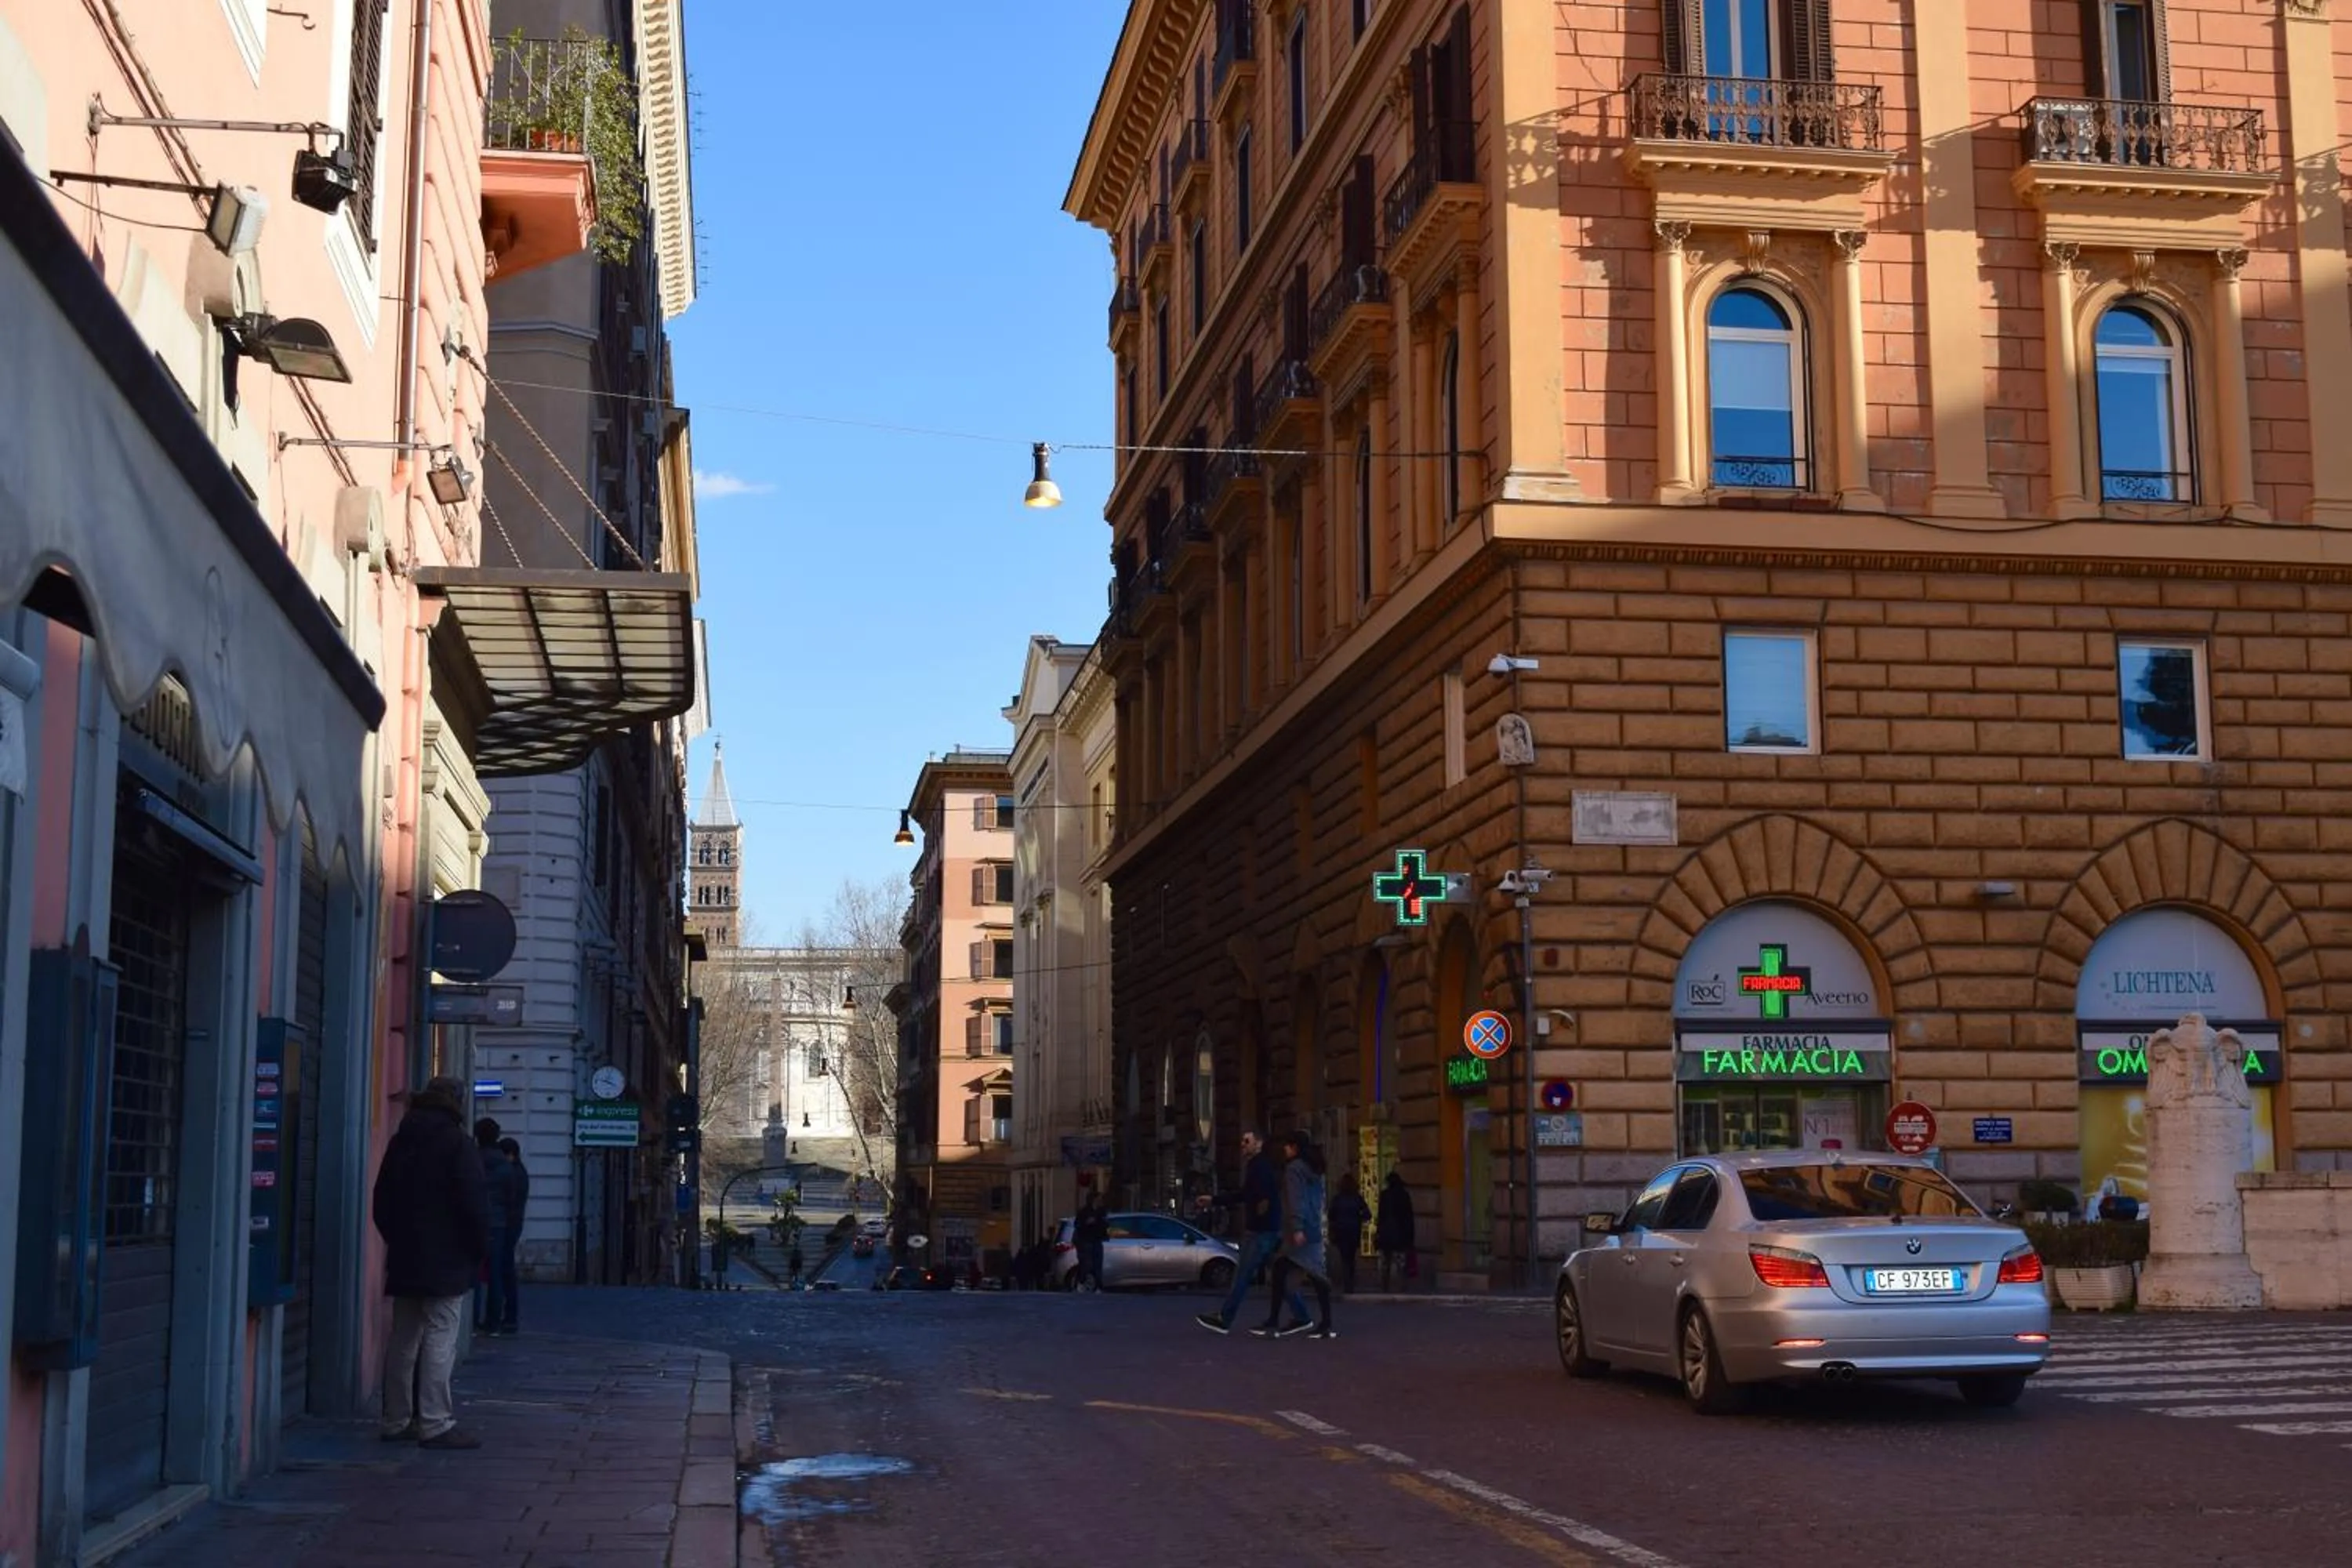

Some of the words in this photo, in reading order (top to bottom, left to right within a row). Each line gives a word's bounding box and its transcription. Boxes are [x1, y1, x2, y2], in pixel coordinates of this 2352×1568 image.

[1743, 976, 1802, 990] FARMACIA
[2113, 971, 2216, 993] LICHTENA
[1804, 991, 1869, 1005] Aveeno
[1743, 1035, 1831, 1051] FARMACIA
[1703, 1049, 1863, 1074] FARMACIA
[1878, 1272, 1895, 1288] CF
[1902, 1271, 1950, 1288] 973EF
